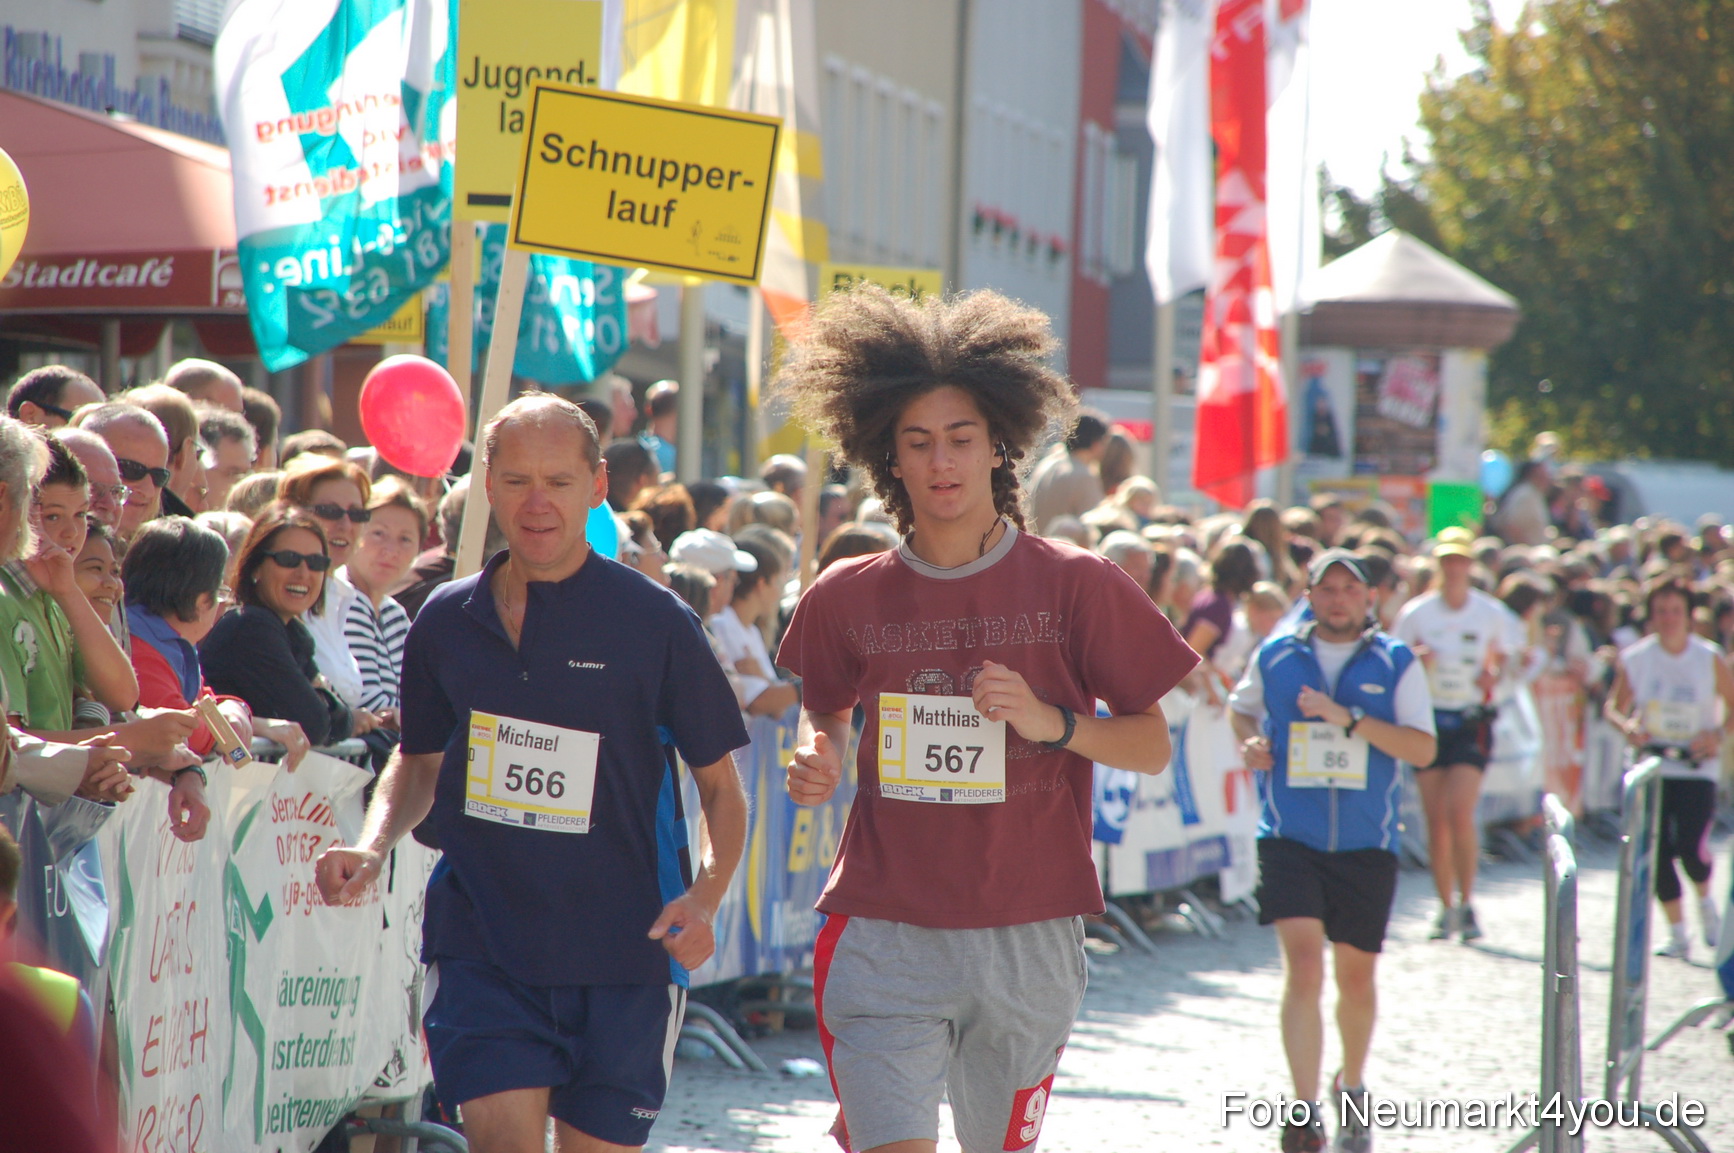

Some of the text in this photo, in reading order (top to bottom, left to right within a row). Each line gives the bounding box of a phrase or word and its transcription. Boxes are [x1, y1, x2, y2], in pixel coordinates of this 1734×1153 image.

[499, 101, 525, 134] la
[540, 132, 755, 192] Schnupper-
[607, 189, 679, 229] lauf
[0, 256, 175, 289] Stadtcafé
[575, 661, 606, 670] LIMIT
[912, 704, 981, 729] Matthias
[496, 723, 560, 753] Michael
[884, 734, 892, 750] D
[468, 747, 475, 762] D
[924, 744, 985, 774] 567
[1323, 750, 1350, 769] 86
[504, 763, 566, 799] 566
[954, 788, 1003, 798] PFLEIDERER
[537, 813, 587, 826] PFLEIDERER
[1020, 1086, 1047, 1143] 9
